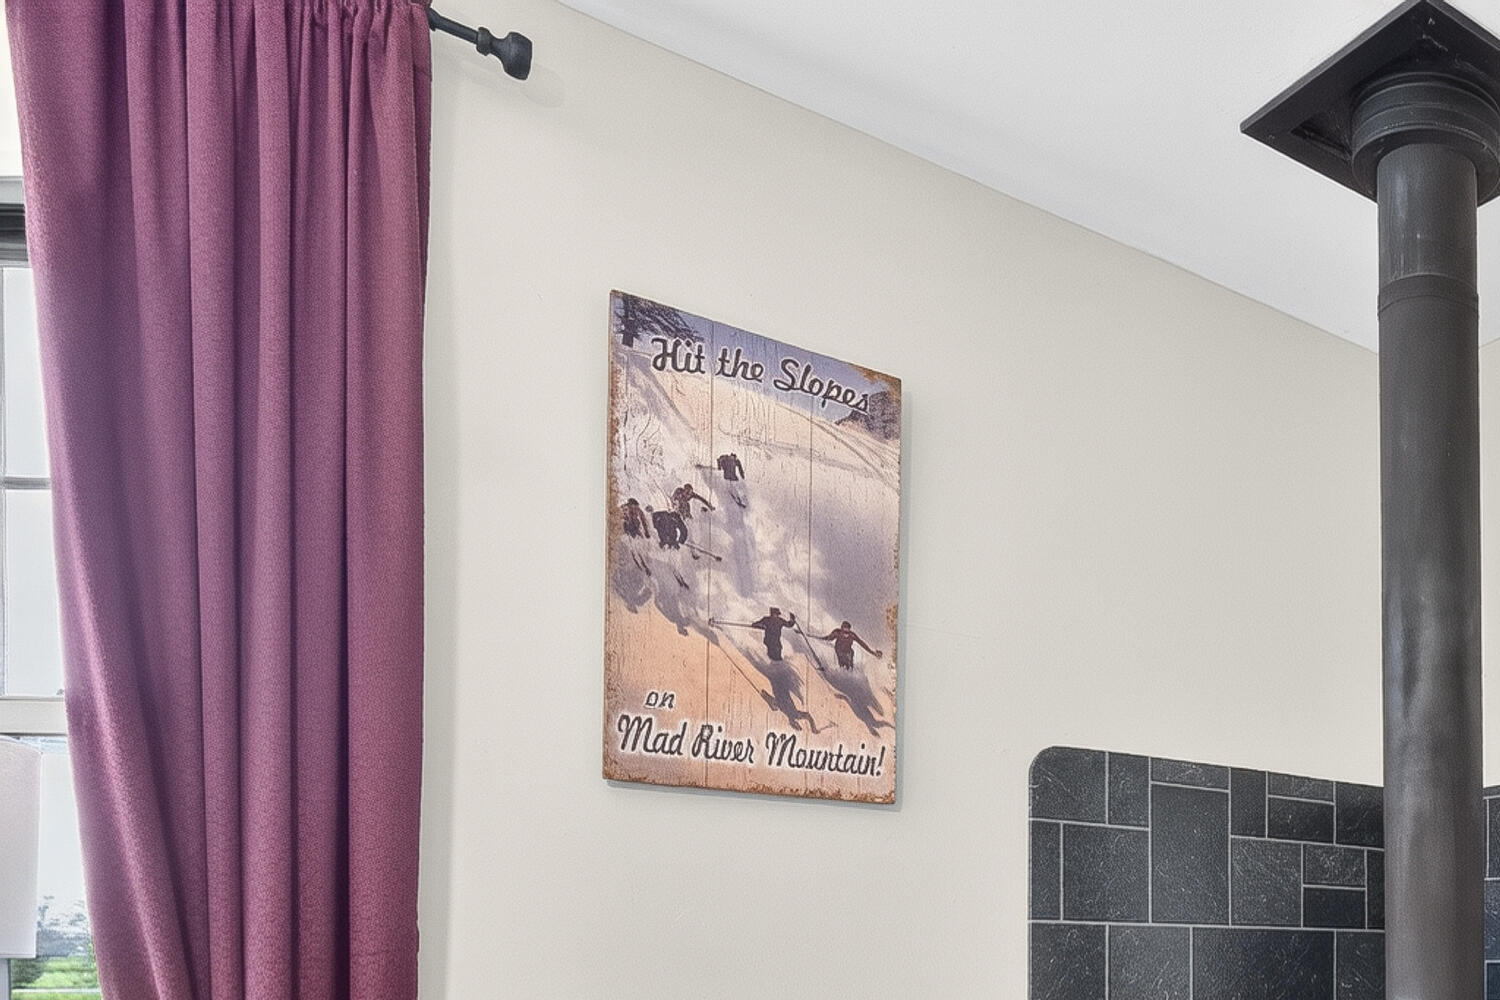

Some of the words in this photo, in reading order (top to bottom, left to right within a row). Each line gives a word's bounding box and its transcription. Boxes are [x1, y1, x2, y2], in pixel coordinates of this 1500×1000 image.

[651, 337, 706, 375] Hit
[715, 347, 764, 383] the
[773, 358, 871, 413] Slopes
[645, 690, 675, 709] on
[617, 713, 688, 756] Mad
[692, 724, 755, 764] River
[766, 731, 886, 777] Mountain!
